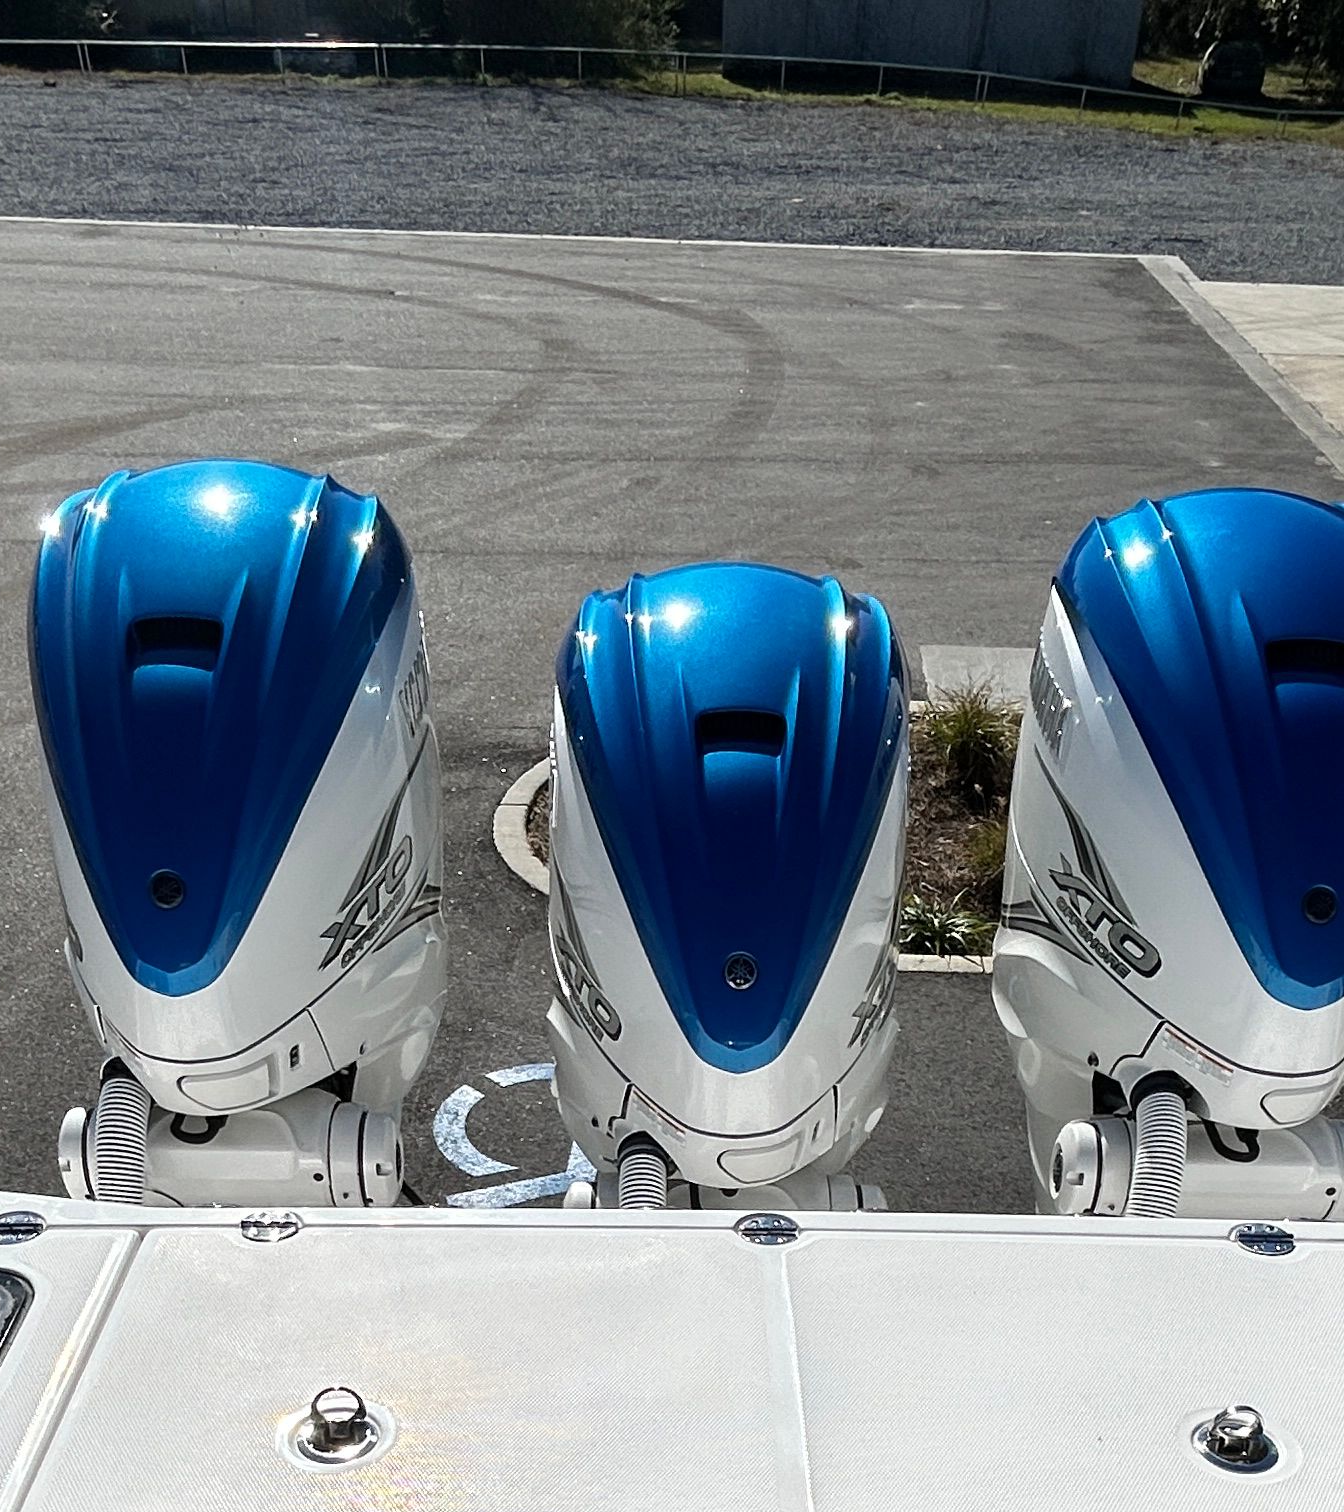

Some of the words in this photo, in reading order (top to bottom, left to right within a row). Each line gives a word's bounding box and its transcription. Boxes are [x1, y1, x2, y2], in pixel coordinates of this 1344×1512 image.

[318, 834, 413, 971] XTO
[1047, 852, 1162, 978] XTO
[1056, 896, 1131, 979] OFFSHORE
